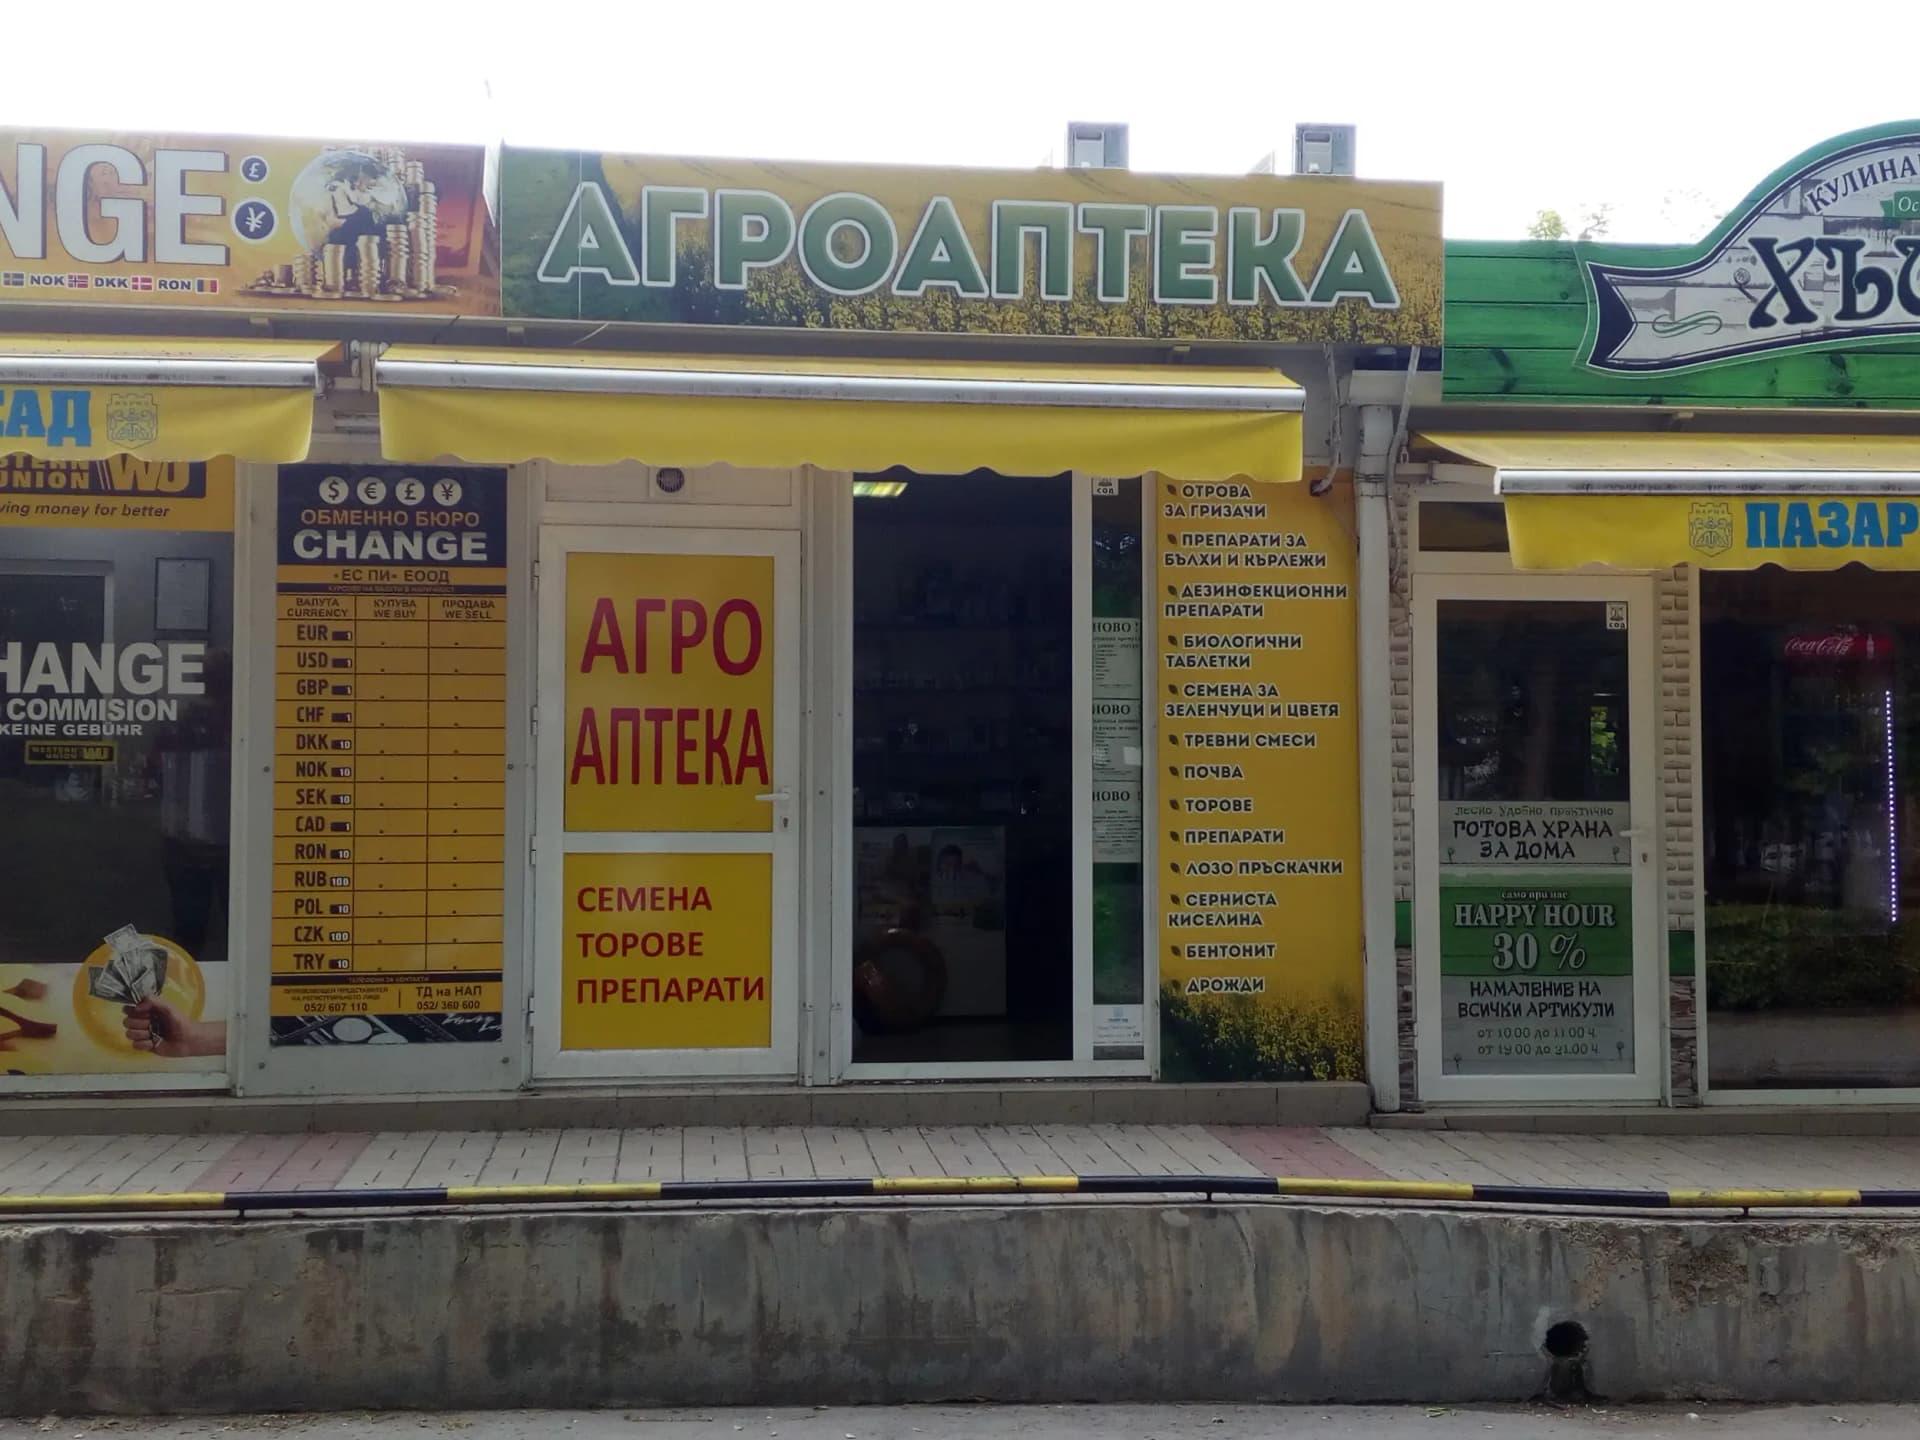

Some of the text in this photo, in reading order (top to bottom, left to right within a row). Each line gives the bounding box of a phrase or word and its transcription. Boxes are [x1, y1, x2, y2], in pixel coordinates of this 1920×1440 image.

[1807, 154, 1920, 212] КУЛИНА
[537, 181, 1401, 309] АГРОАПТЕКА
[30, 274, 191, 291] NOK DKK RON
[0, 389, 92, 447] АД
[1182, 485, 1251, 498] ОТРОВА
[34, 504, 89, 518] money
[94, 503, 118, 517] for
[121, 503, 170, 519] better
[301, 509, 480, 527] ОБМЕННО БЮРО
[1165, 504, 1266, 517] ЗА ГРИЗАЧИ
[1745, 502, 1920, 549] ПАЗАР
[293, 529, 487, 561] CHANGE
[1182, 534, 1307, 547] ПРЕПАРАТИ ЗА
[1165, 554, 1327, 567] БЪЛХИ И КЪРЛЕЖИ
[404, 570, 449, 584] ЕООД
[1181, 585, 1347, 598] ДЕЗИНФЕКЦИОННИ
[296, 598, 495, 610] ВАЛУТА КУПУВА ПРОДАВА
[1165, 605, 1264, 617] ПРЕПАРАТИ
[287, 608, 491, 619] CURRENCY WE BUY WE SELL
[297, 625, 328, 641] EUR
[580, 597, 763, 676] АГРО
[1184, 635, 1302, 648] БИОЛОГИЧНИ
[297, 652, 328, 668] USD
[1166, 655, 1251, 668] ТАБЛЕТКИ
[297, 679, 328, 695] GBP
[1184, 684, 1279, 697] СЕМЕНА ЗА
[6, 699, 178, 721] COMMISION
[297, 707, 325, 722] CHF
[1166, 704, 1339, 717] ЗЕЛЕНЧУЦИ И ЦВЕТЯ
[62, 721, 143, 736] GEBÜHR
[296, 734, 350, 750] DKK 10
[570, 706, 769, 786] АПТЕКА
[1185, 734, 1317, 747] ТРЕВНИ СМЕСИ
[296, 761, 350, 777] NOK 10
[1184, 766, 1244, 778] ПОЧВА
[296, 789, 350, 805] SEK 10
[1185, 799, 1253, 812] ТОРОВЕ
[296, 816, 325, 832] CAD
[1453, 820, 1613, 838] ГОТОВА ХРАНА
[1185, 830, 1285, 843] ПРЕПАРАТИ
[295, 843, 349, 859] RON 10
[1480, 841, 1576, 860] ЗА ДОМА
[1186, 861, 1343, 875] ЛОЗО ПРЪСКАЧКИ
[295, 871, 349, 887] RUB 100
[294, 898, 349, 914] POL 10
[576, 886, 713, 912] СЕМЕНА
[1186, 893, 1278, 906] СЕРНИСТА
[1168, 914, 1263, 927] КИСЕЛИНА
[1454, 903, 1616, 927] HAPPY HOUR
[294, 926, 348, 942] CZK 100
[576, 932, 704, 958] ТОРОВЕ
[1186, 944, 1276, 958] БЕНТОНИТ
[1492, 932, 1586, 970] 30 %
[293, 953, 348, 970] TRY 10
[416, 985, 482, 999] ТД на НАП
[576, 976, 765, 1004] ПРЕПАРАТИ
[1187, 979, 1265, 992] ДРОЖДИ
[1470, 981, 1602, 998] НАМАЛЕНИЕ НА
[417, 1001, 438, 1010] 052/
[1458, 1002, 1615, 1018] ВСИЧКИ АРТИКУЛИ
[1478, 1029, 1492, 1038] от
[1535, 1029, 1550, 1040] до
[1478, 1046, 1492, 1055] от
[1535, 1046, 1551, 1057] до
